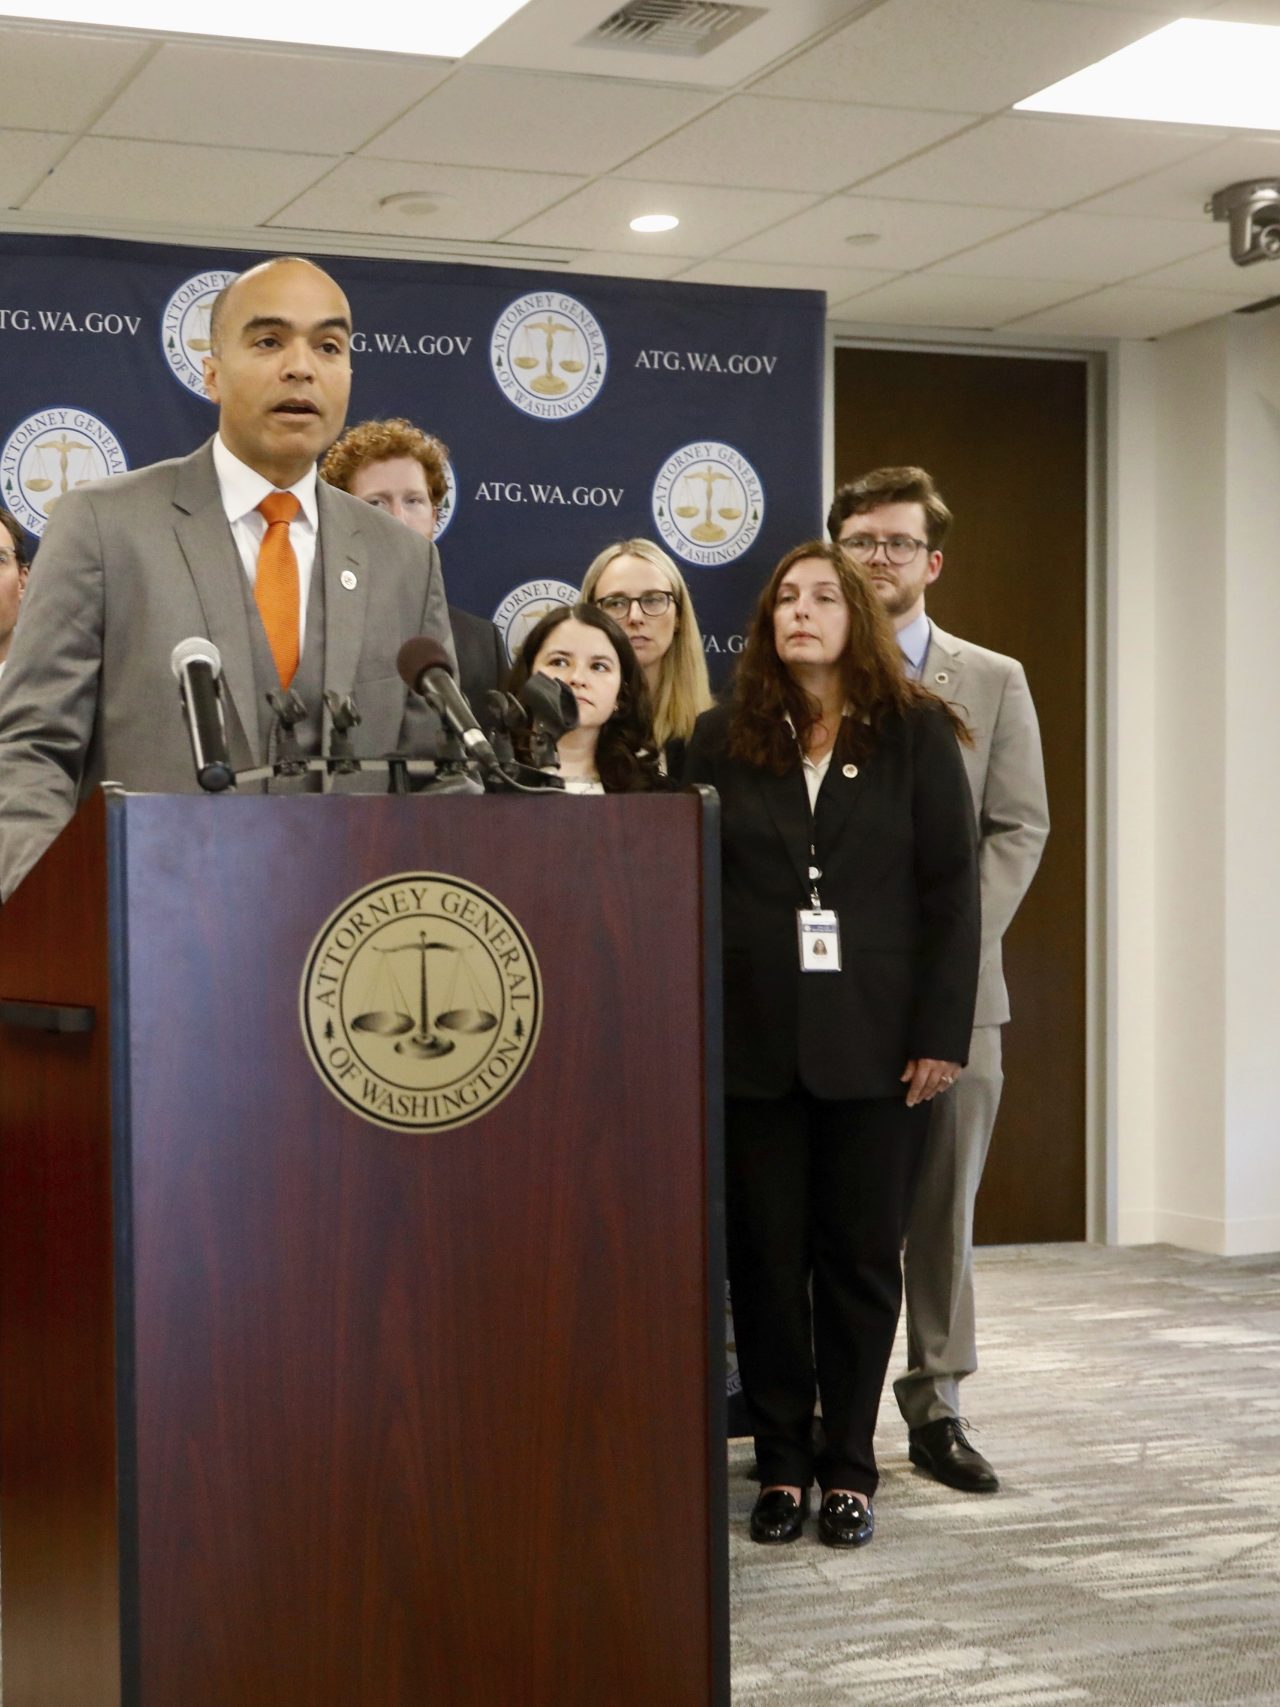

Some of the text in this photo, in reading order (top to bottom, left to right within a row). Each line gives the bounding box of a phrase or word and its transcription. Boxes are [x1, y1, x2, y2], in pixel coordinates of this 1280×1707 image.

[349, 332, 472, 356] G.WA.GOV
[494, 294, 604, 361] ATTORNEY GENERAL
[170, 352, 189, 372] OF
[634, 350, 778, 375] ATG.WA.GOV
[499, 371, 599, 417] OF WASHINGTON
[3, 411, 68, 476] ATTORNEY
[475, 482, 624, 507] ATG.WA.GOV
[656, 445, 761, 507] ATTORNEY GENERAL
[8, 494, 28, 514] OF
[661, 520, 758, 563] OF WASHINGTON
[315, 887, 531, 1011] ATTORNEY GENERAL
[328, 1037, 520, 1119] OF WASHINGTON
